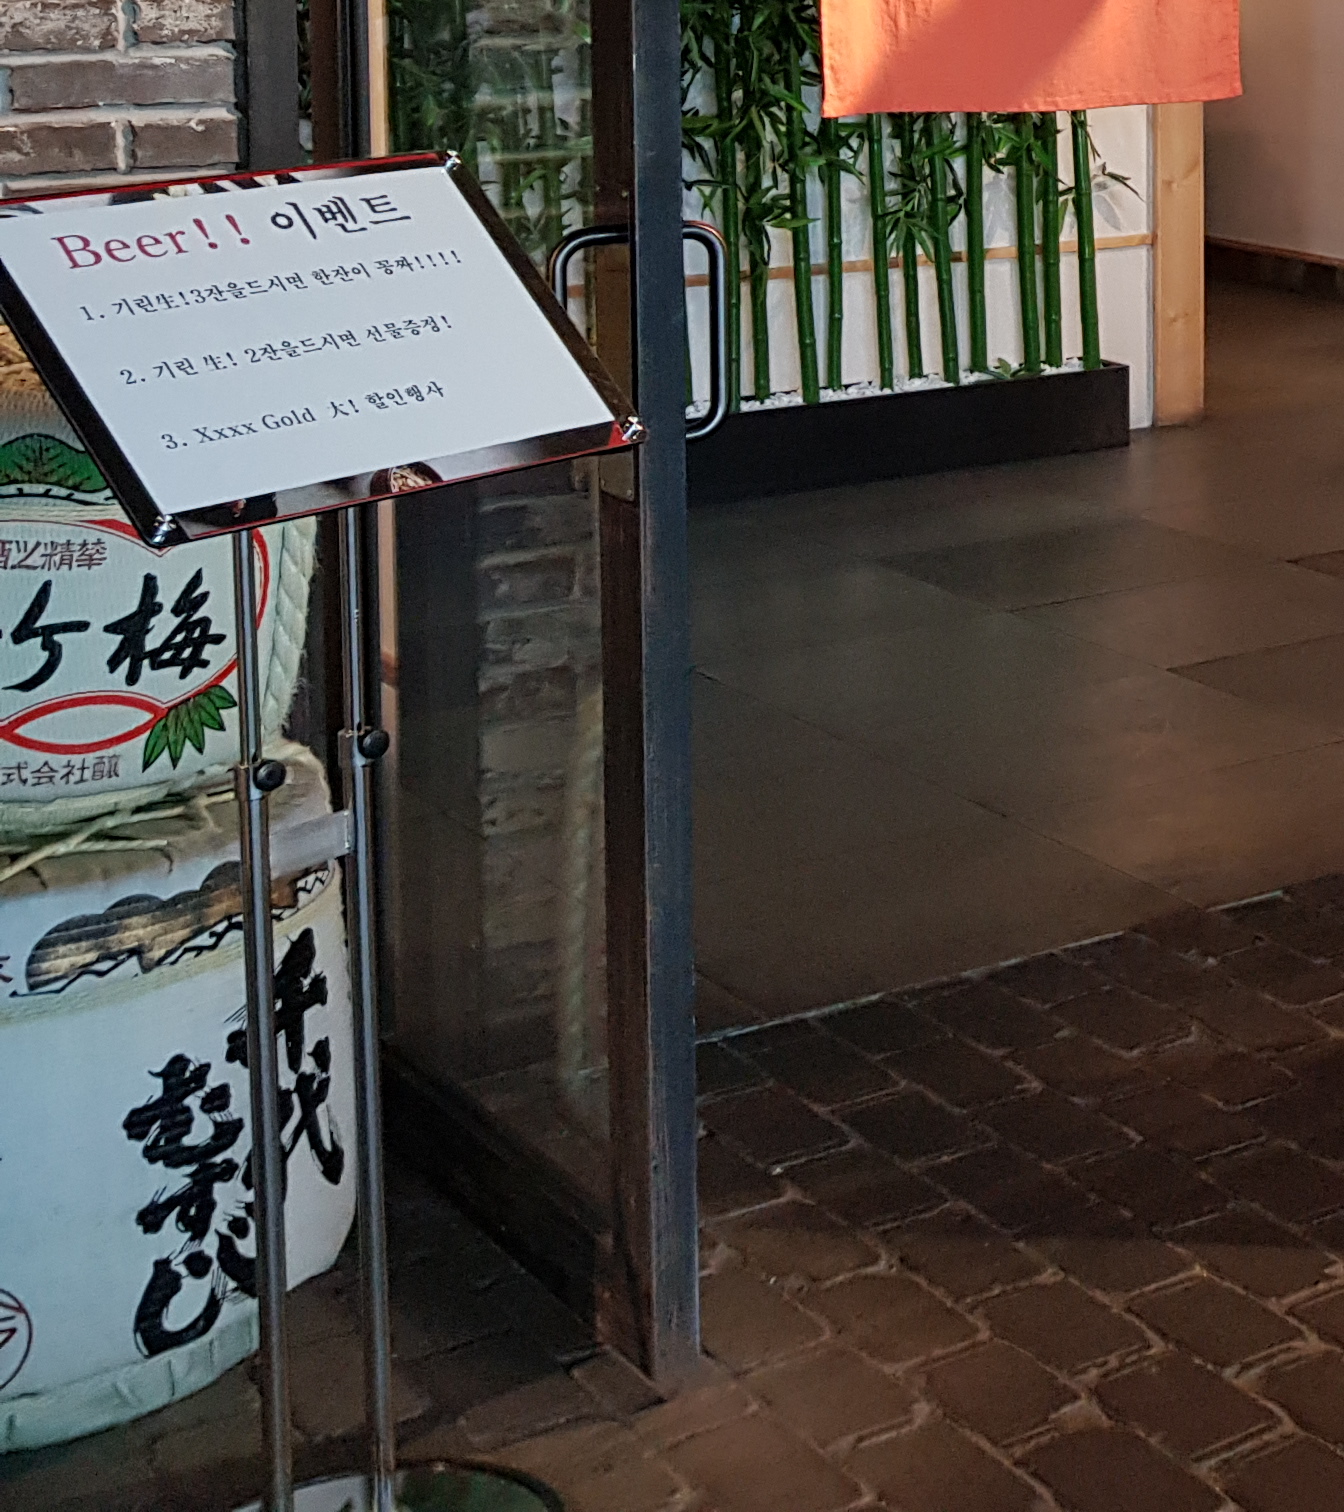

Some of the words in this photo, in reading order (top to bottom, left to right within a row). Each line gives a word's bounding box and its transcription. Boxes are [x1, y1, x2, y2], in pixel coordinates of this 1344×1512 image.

[51, 214, 251, 269] Beer!!
[270, 194, 411, 239] 이벤트
[79, 304, 106, 321] 1.
[311, 262, 371, 286] 한잔이
[374, 250, 461, 275] 꽁짜!!!!
[120, 369, 146, 386] 2.
[153, 357, 199, 381] 기린
[244, 329, 361, 364] 2잔을드시면
[366, 315, 453, 343] 선물증정!
[161, 433, 188, 450] 3.
[193, 421, 259, 444] Xxxx
[261, 407, 317, 431] Gold
[326, 397, 360, 419] 大!
[364, 381, 445, 411] 할인행사
